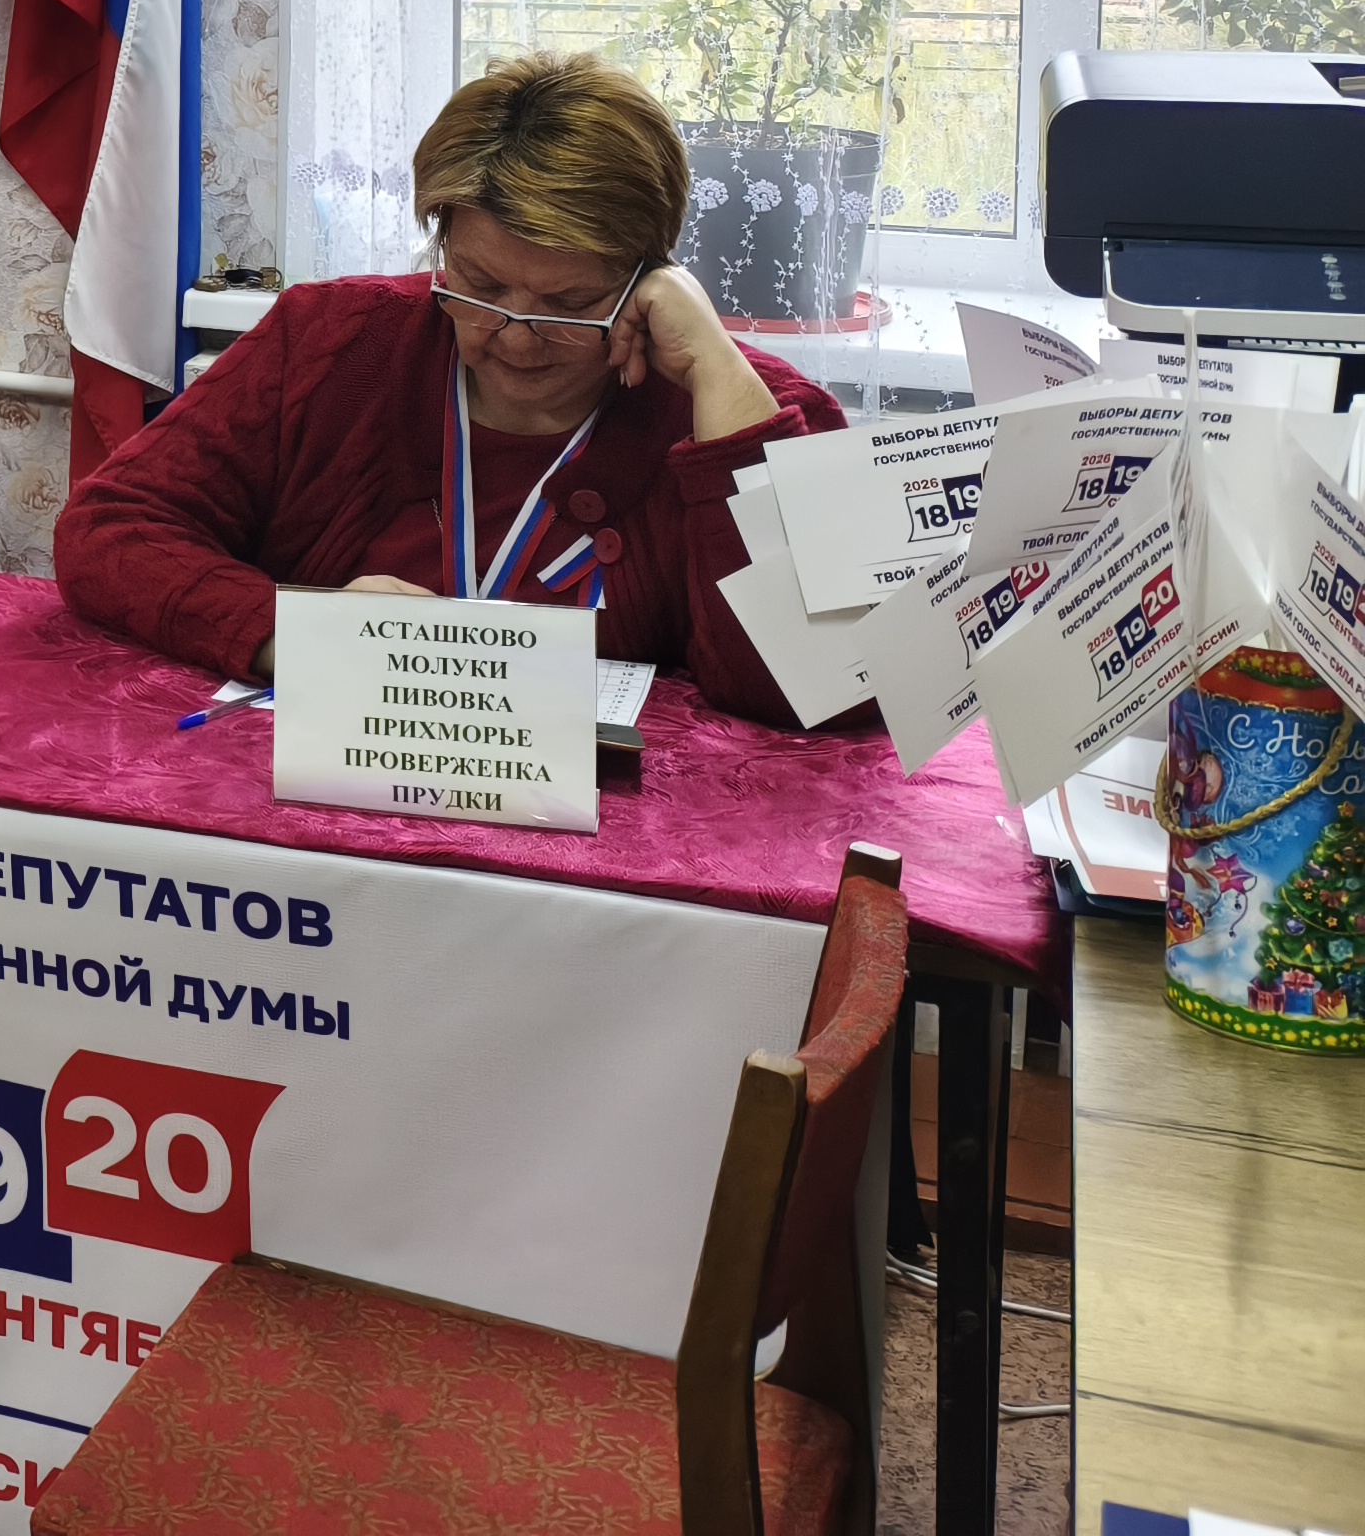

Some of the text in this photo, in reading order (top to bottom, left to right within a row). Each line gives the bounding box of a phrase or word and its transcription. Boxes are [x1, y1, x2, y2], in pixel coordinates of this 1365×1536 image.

[1157, 354, 1233, 373] ВЫБОР ЕПУТАТОВ
[1079, 407, 1138, 422] ВЫБОРЫ
[871, 427, 939, 448] ВЫБОРЫ
[1081, 453, 1111, 467] 2026
[902, 477, 940, 493] 2026
[1078, 465, 1144, 501] 18 19
[915, 504, 950, 530] 18
[949, 485, 982, 511] 19
[1022, 532, 1054, 551] ТВОЙ
[1314, 540, 1336, 567] 2026
[873, 565, 916, 584] ТВОЙ
[926, 551, 969, 589] ВЫБОР
[1032, 569, 1070, 616] ВЫБОРЫ
[1071, 516, 1120, 577] ДЕПУТАТОВ
[1057, 573, 1107, 621] ВЫБОРЫ
[1107, 520, 1171, 579] ДЕПУТАТОВ
[967, 561, 1045, 650] 18 19 20
[1061, 560, 1150, 640] ГОСУДАРСТВЕННОЙ
[1310, 570, 1329, 602] 18
[1335, 578, 1355, 611] 19
[955, 596, 983, 622] 2026
[359, 620, 537, 649] АСТАШКОВО
[1086, 626, 1115, 654] 2026
[1099, 579, 1174, 682] 18 19 20
[1134, 620, 1184, 669] СЕНТЯБР
[387, 653, 508, 680] МОЛУКИ
[1292, 615, 1322, 653] ГОЛОС
[1329, 656, 1355, 690] СИЛА
[382, 685, 514, 713] ПИВОВКА
[1074, 722, 1109, 755] ТВОЙ
[1108, 692, 1148, 730] ГОЛОС
[1156, 659, 1188, 689] СИЛА
[1196, 620, 1240, 657] ОССИИ!
[947, 690, 978, 721] ТВОЙ
[363, 716, 533, 748] ПРИХМОРЬЕ
[344, 747, 553, 783] ПРОВЕРЖЕНКА
[391, 784, 502, 812] ПРУДКИ
[167, 974, 351, 1040] ДУМЫ
[63, 1095, 233, 1214] 20
